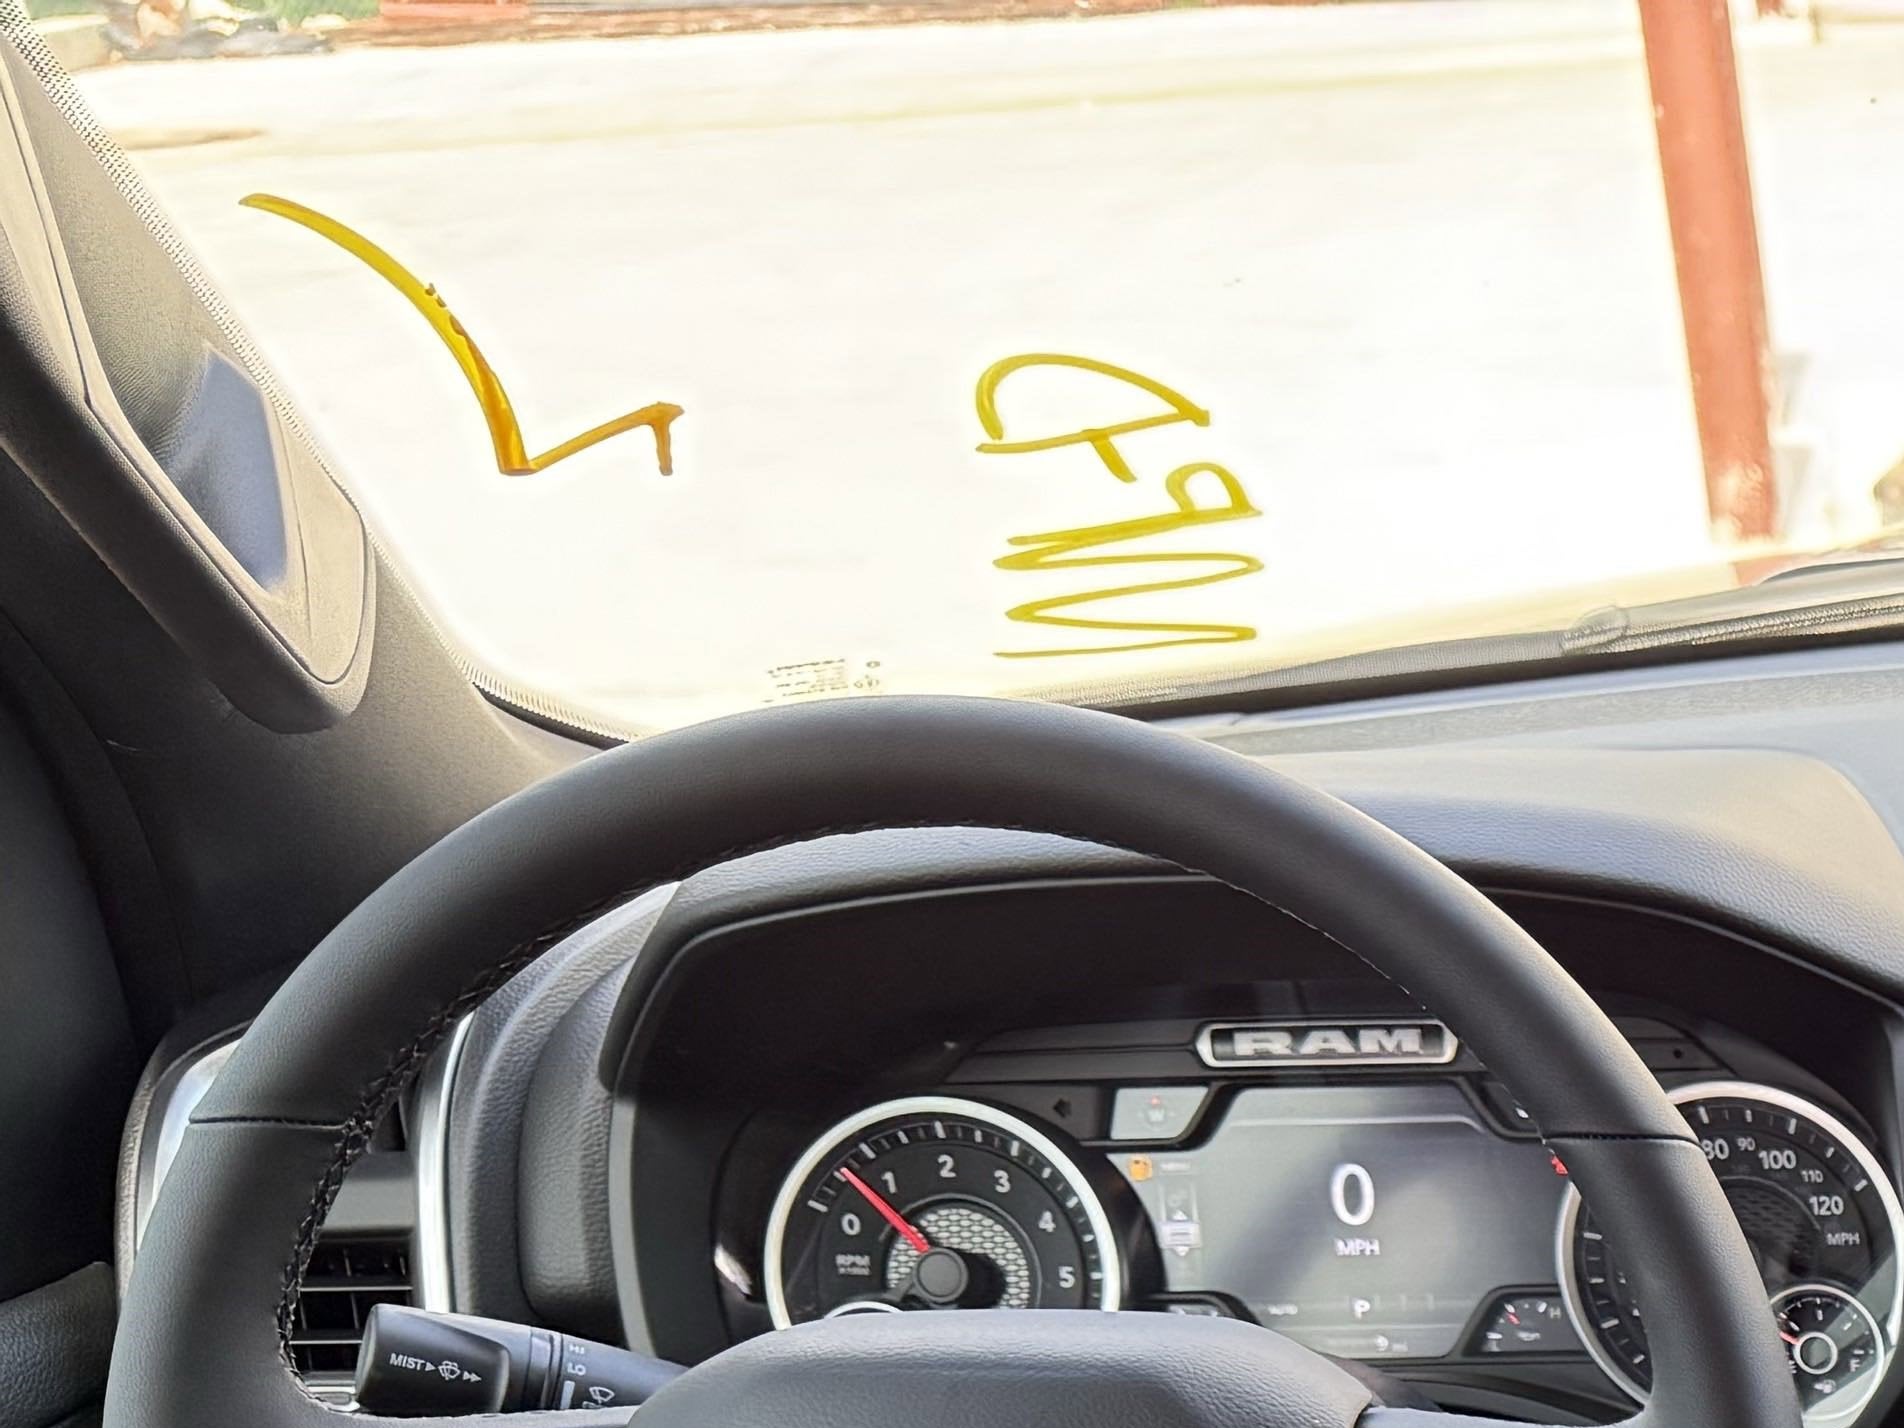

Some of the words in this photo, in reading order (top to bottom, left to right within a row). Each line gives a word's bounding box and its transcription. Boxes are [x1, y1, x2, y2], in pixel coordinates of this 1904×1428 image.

[1233, 1028, 1424, 1056] RAM
[1736, 1137, 1756, 1151] 90
[938, 1155, 956, 1178] 2
[1758, 1150, 1797, 1170] 100
[881, 1171, 898, 1195] 1
[993, 1170, 1011, 1193] 3
[1801, 1169, 1823, 1184] 110
[1330, 1162, 1376, 1226] 0
[1809, 1195, 1844, 1216] 120
[840, 1213, 861, 1236] 0
[1037, 1210, 1056, 1233] 4
[1335, 1238, 1380, 1257] MPH
[1827, 1232, 1860, 1246] MPH
[1058, 1265, 1075, 1289] 5
[389, 1352, 426, 1371] MIST
[567, 1362, 587, 1376] LO
